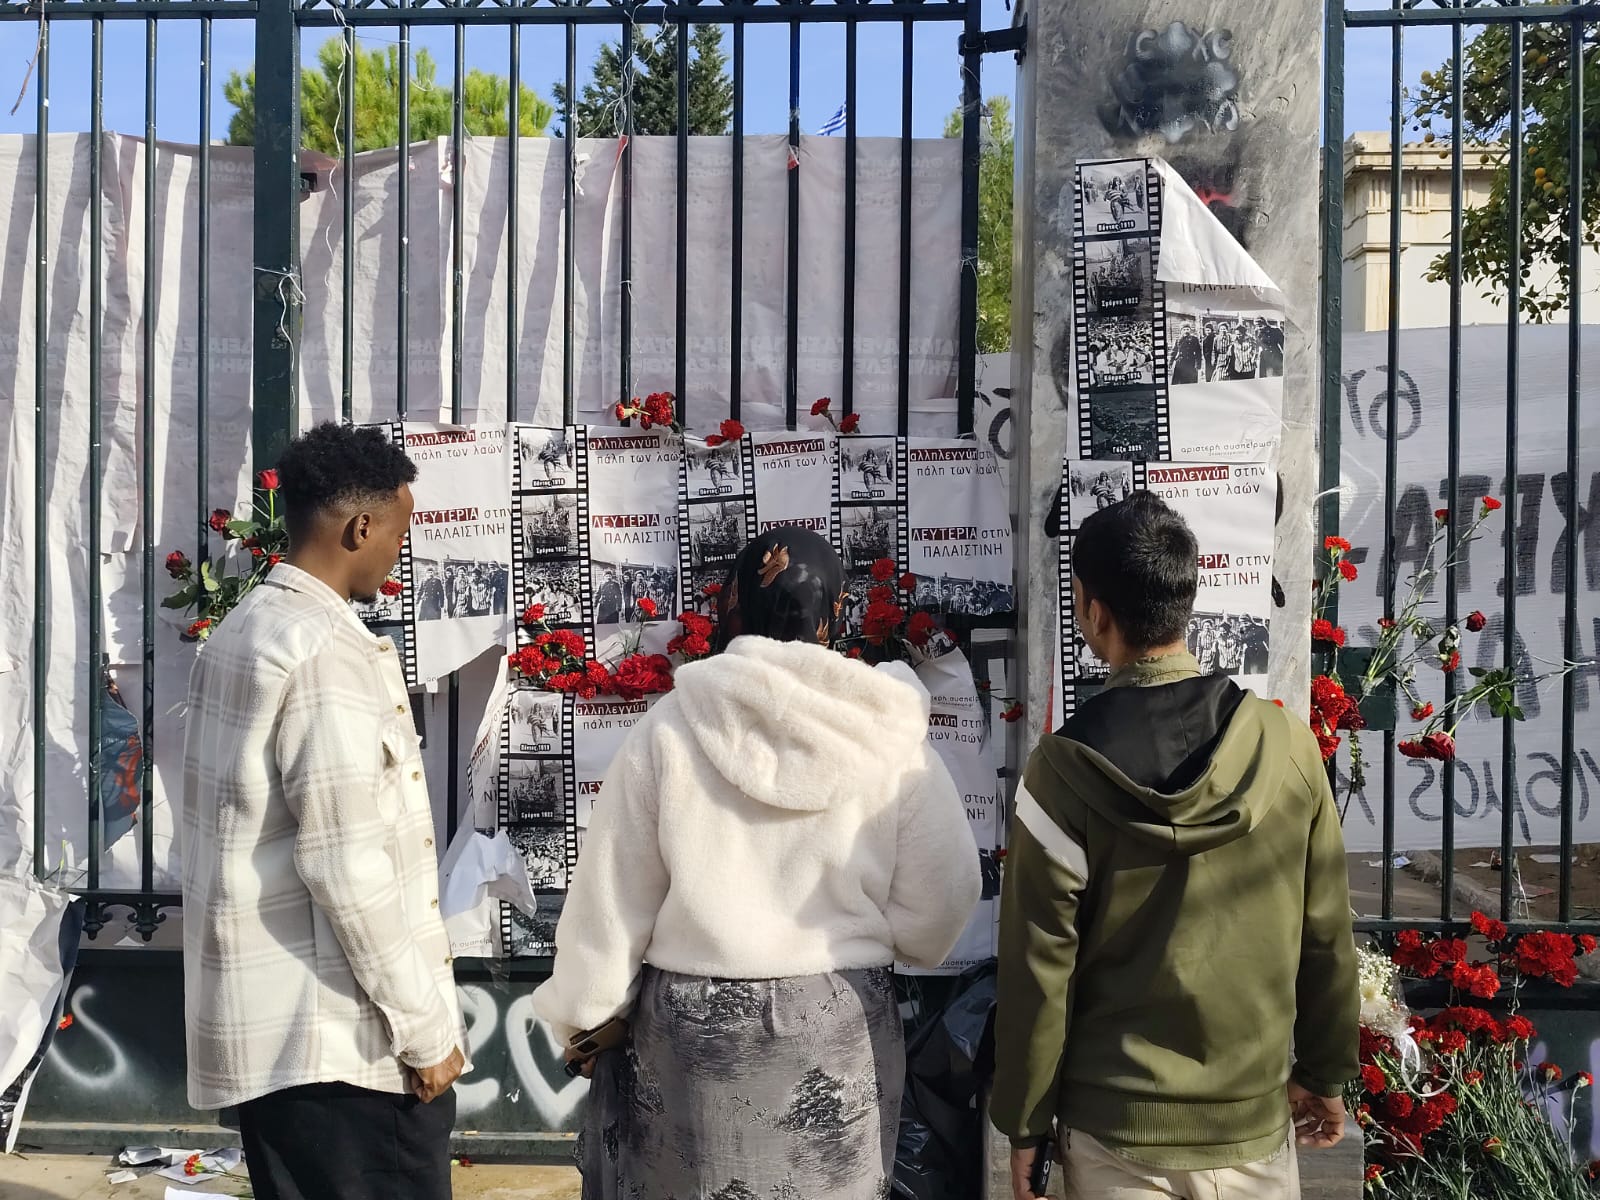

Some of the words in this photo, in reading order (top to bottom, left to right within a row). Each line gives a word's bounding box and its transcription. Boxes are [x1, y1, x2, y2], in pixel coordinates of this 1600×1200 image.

[406, 430, 476, 447] αλληλεγγύη
[480, 429, 508, 439] στην
[589, 436, 660, 450] αλληλεγγύη
[414, 449, 443, 461] πάλη
[446, 447, 469, 459] των
[473, 444, 503, 456] λαών
[755, 439, 825, 456] αλληλεγγύη
[910, 448, 978, 462] αλληλεγγύη
[596, 454, 625, 465] πάλη
[630, 453, 652, 463] των
[762, 459, 791, 471] πάλη
[796, 456, 817, 467] των
[916, 465, 945, 477] πάλη
[950, 465, 972, 475] των
[975, 463, 998, 475] λαών
[1149, 466, 1229, 484] αλληλεγγύη
[1234, 466, 1266, 478] στην
[1194, 487, 1220, 498] των
[1226, 482, 1260, 495] λαών
[412, 508, 479, 526] ΛΕΥΤΕΡΙΑ
[592, 514, 660, 529] ΛΕΥΤΕΡΙΑ
[664, 516, 679, 526] στ
[424, 522, 506, 541] ΠΑΛΑΙΣΤΙΝΗ
[604, 531, 679, 545] ΠΑΛΑΙΣΤΙΝ
[912, 527, 977, 541] ΛΕΥΤΕΡΙΑ
[981, 529, 1010, 539] στην
[923, 543, 1003, 558] ΠΑΛΑΙΣΤΙΝΗ
[1197, 554, 1230, 569] ΕΡΙΑ
[1236, 555, 1271, 567] στην
[1198, 571, 1261, 588] ΑΙΣΤΙΝΗ
[576, 702, 648, 716] αλληλεγγύη
[583, 718, 612, 730] πάλη
[617, 718, 639, 728] των
[929, 731, 950, 741] των
[954, 731, 983, 743] λαών
[964, 794, 994, 805] στην
